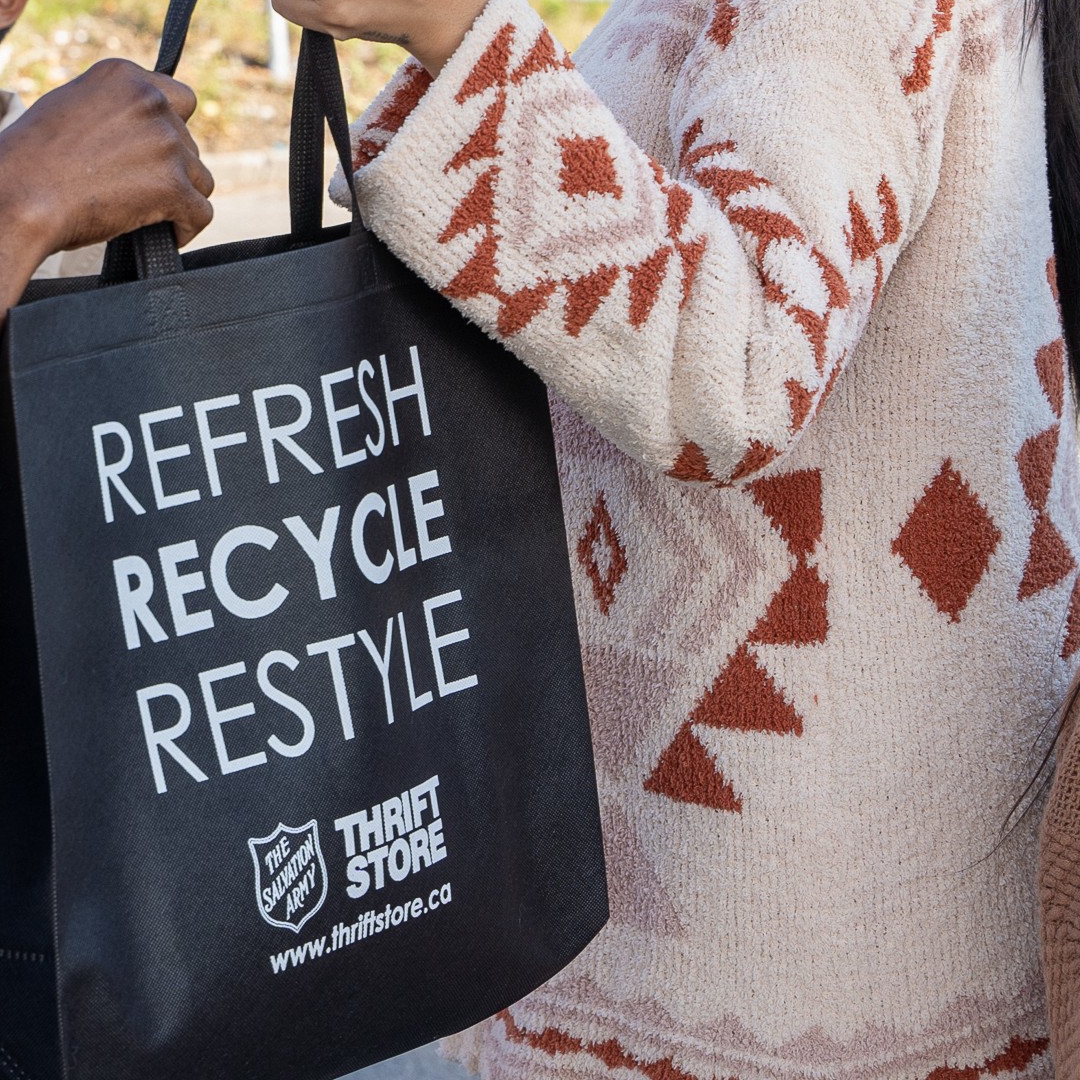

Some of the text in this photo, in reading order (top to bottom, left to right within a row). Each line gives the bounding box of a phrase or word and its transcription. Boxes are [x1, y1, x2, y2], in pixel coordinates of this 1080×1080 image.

[92, 345, 432, 524] REFRESH
[112, 469, 453, 650] RECYCLE
[136, 589, 479, 794] RESTYLE
[264, 835, 291, 875] THE
[334, 774, 440, 857] THRIFT
[261, 833, 315, 913] SALVATION
[285, 862, 316, 921] ARMY
[345, 818, 448, 899] STORE
[269, 882, 453, 974] www.thriftstore.ca
